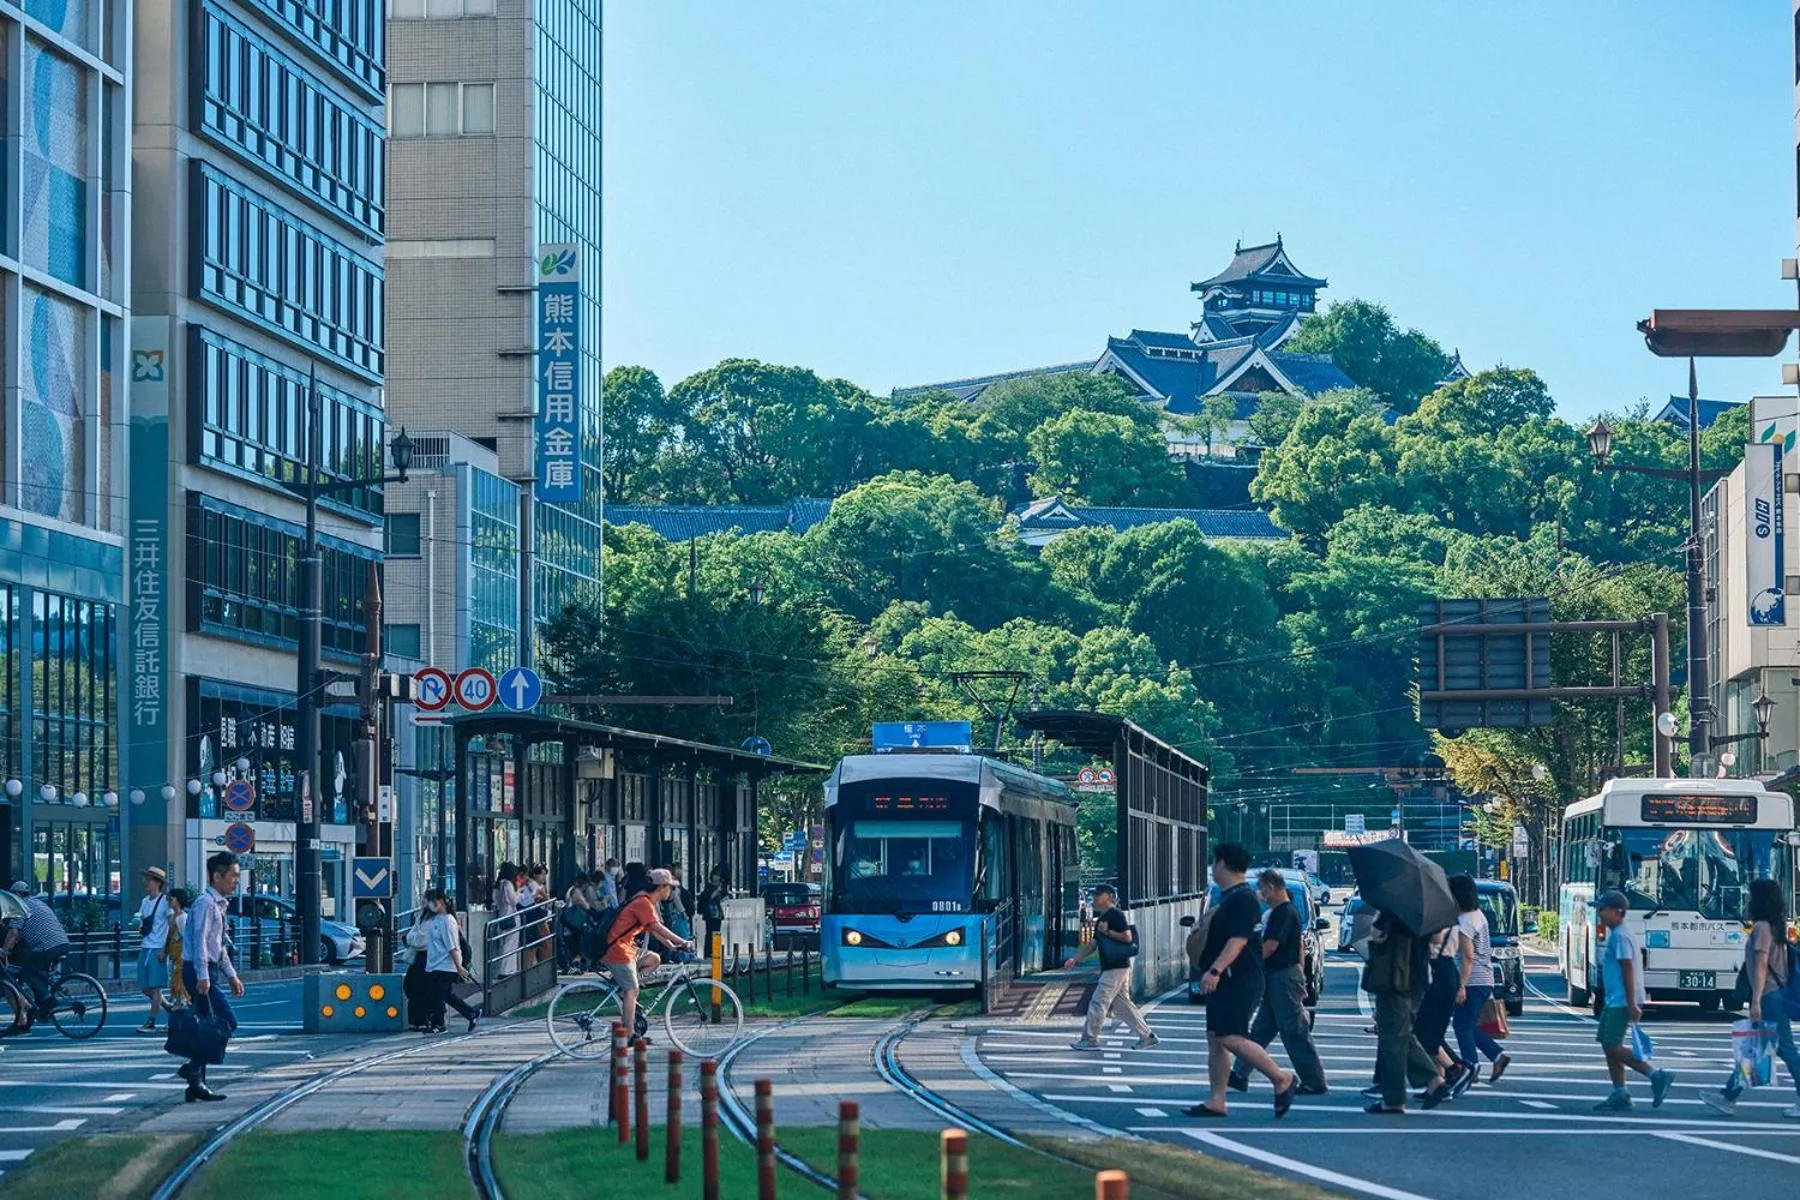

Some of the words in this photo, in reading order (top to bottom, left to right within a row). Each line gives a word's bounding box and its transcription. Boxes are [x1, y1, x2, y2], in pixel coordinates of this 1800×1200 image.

[544, 293, 574, 490] 熊本信用金庫
[1755, 498, 1770, 538] HIS
[134, 519, 160, 726] 三井住友信託銀行
[464, 680, 487, 699] 40
[1671, 921, 1725, 931] 熊本都市バス
[1685, 976, 1714, 988] 30-14
